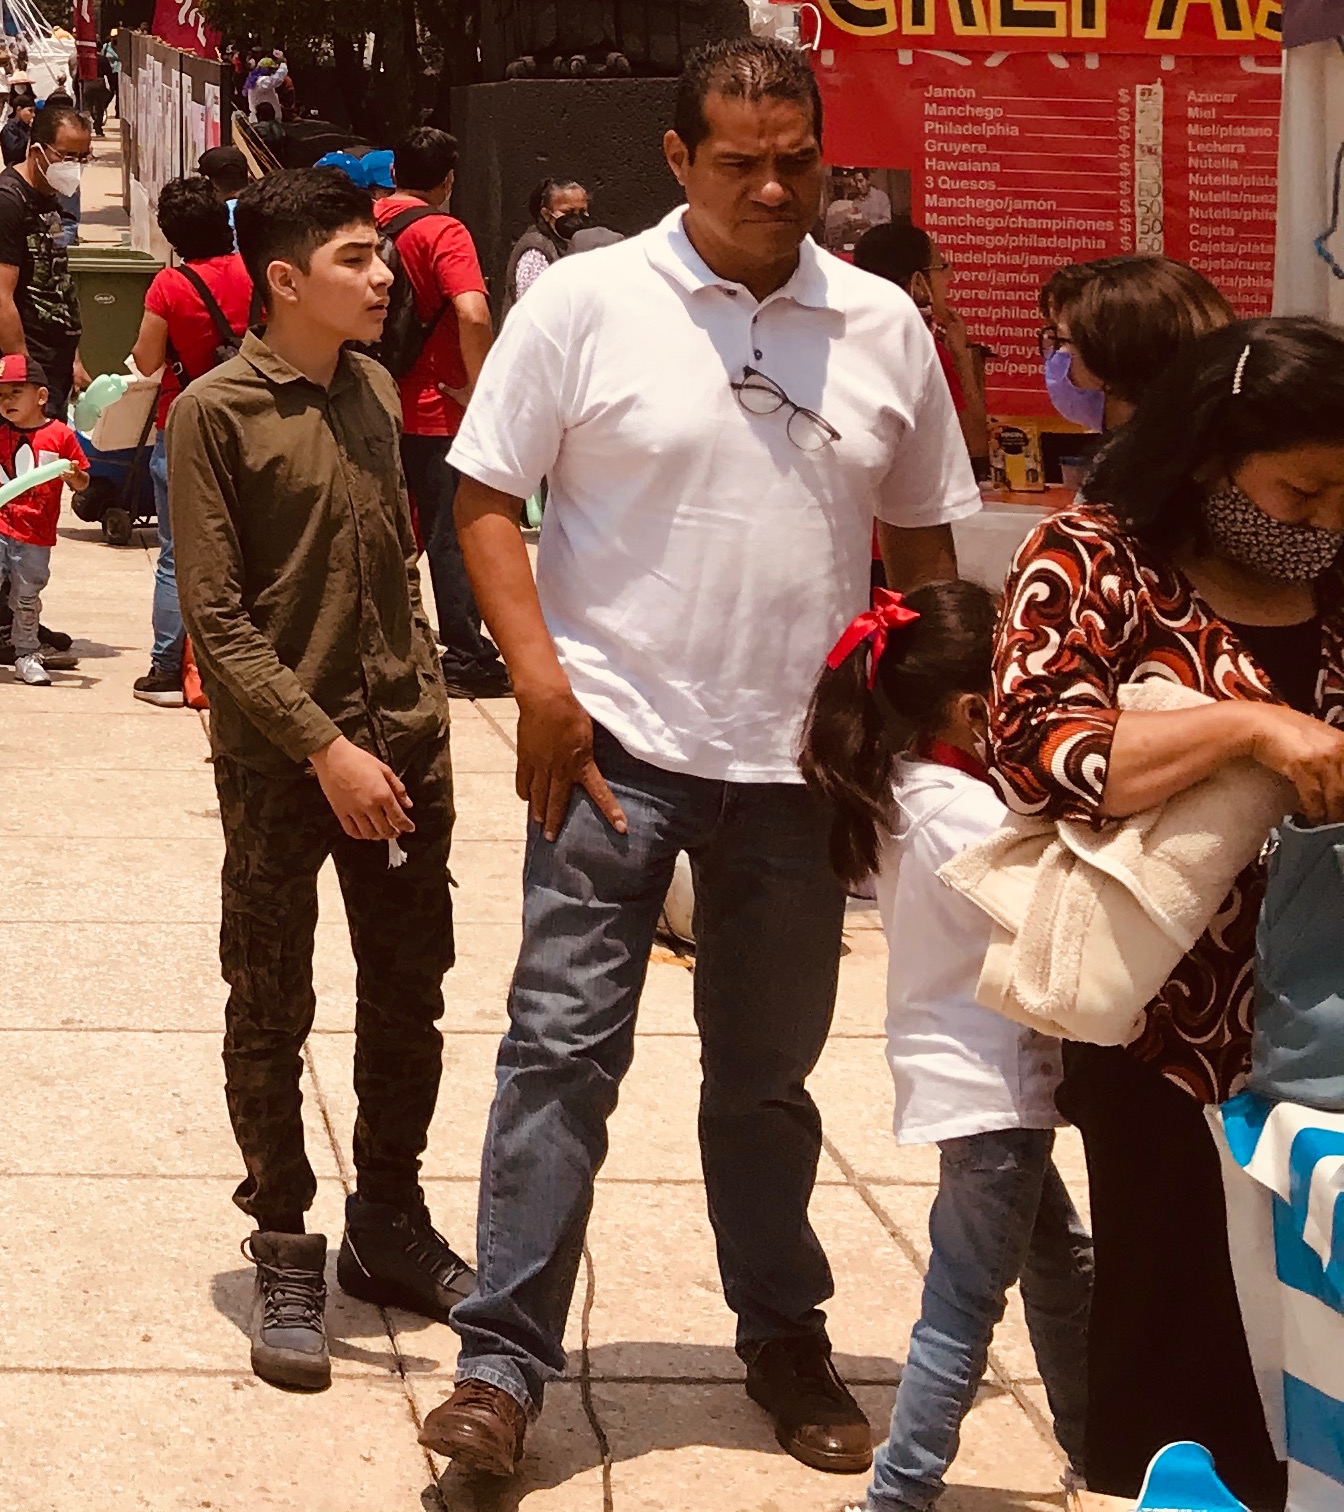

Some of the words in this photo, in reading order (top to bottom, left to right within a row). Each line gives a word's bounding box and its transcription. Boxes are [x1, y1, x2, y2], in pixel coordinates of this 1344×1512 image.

[924, 85, 976, 99] Jamón
[1118, 88, 1131, 103] $
[924, 102, 1003, 120] Manchego
[1117, 107, 1130, 122] $
[1187, 107, 1216, 120] Miel
[924, 121, 1019, 136] Philadelphia
[1118, 125, 1130, 140] $
[924, 139, 987, 155] Gruyere
[1118, 144, 1131, 159] $
[1188, 141, 1245, 154] Lechera
[925, 157, 1001, 172] Hawaiana
[1119, 162, 1131, 177] $
[1188, 157, 1239, 170] Nutella
[925, 176, 934, 188] 3
[938, 177, 996, 190] Quesos
[1119, 180, 1131, 195] $
[925, 194, 1057, 211] Manchego/jamón
[1119, 199, 1131, 214] $
[1137, 199, 1161, 216] 50
[925, 212, 1114, 232] Manchego/champiñones
[1120, 217, 1132, 232] $
[1140, 218, 1163, 235] 50
[1189, 223, 1235, 238] Cajeta
[1120, 236, 1132, 251] $
[1139, 238, 1162, 253] 50
[953, 269, 1040, 285] yere/jamón
